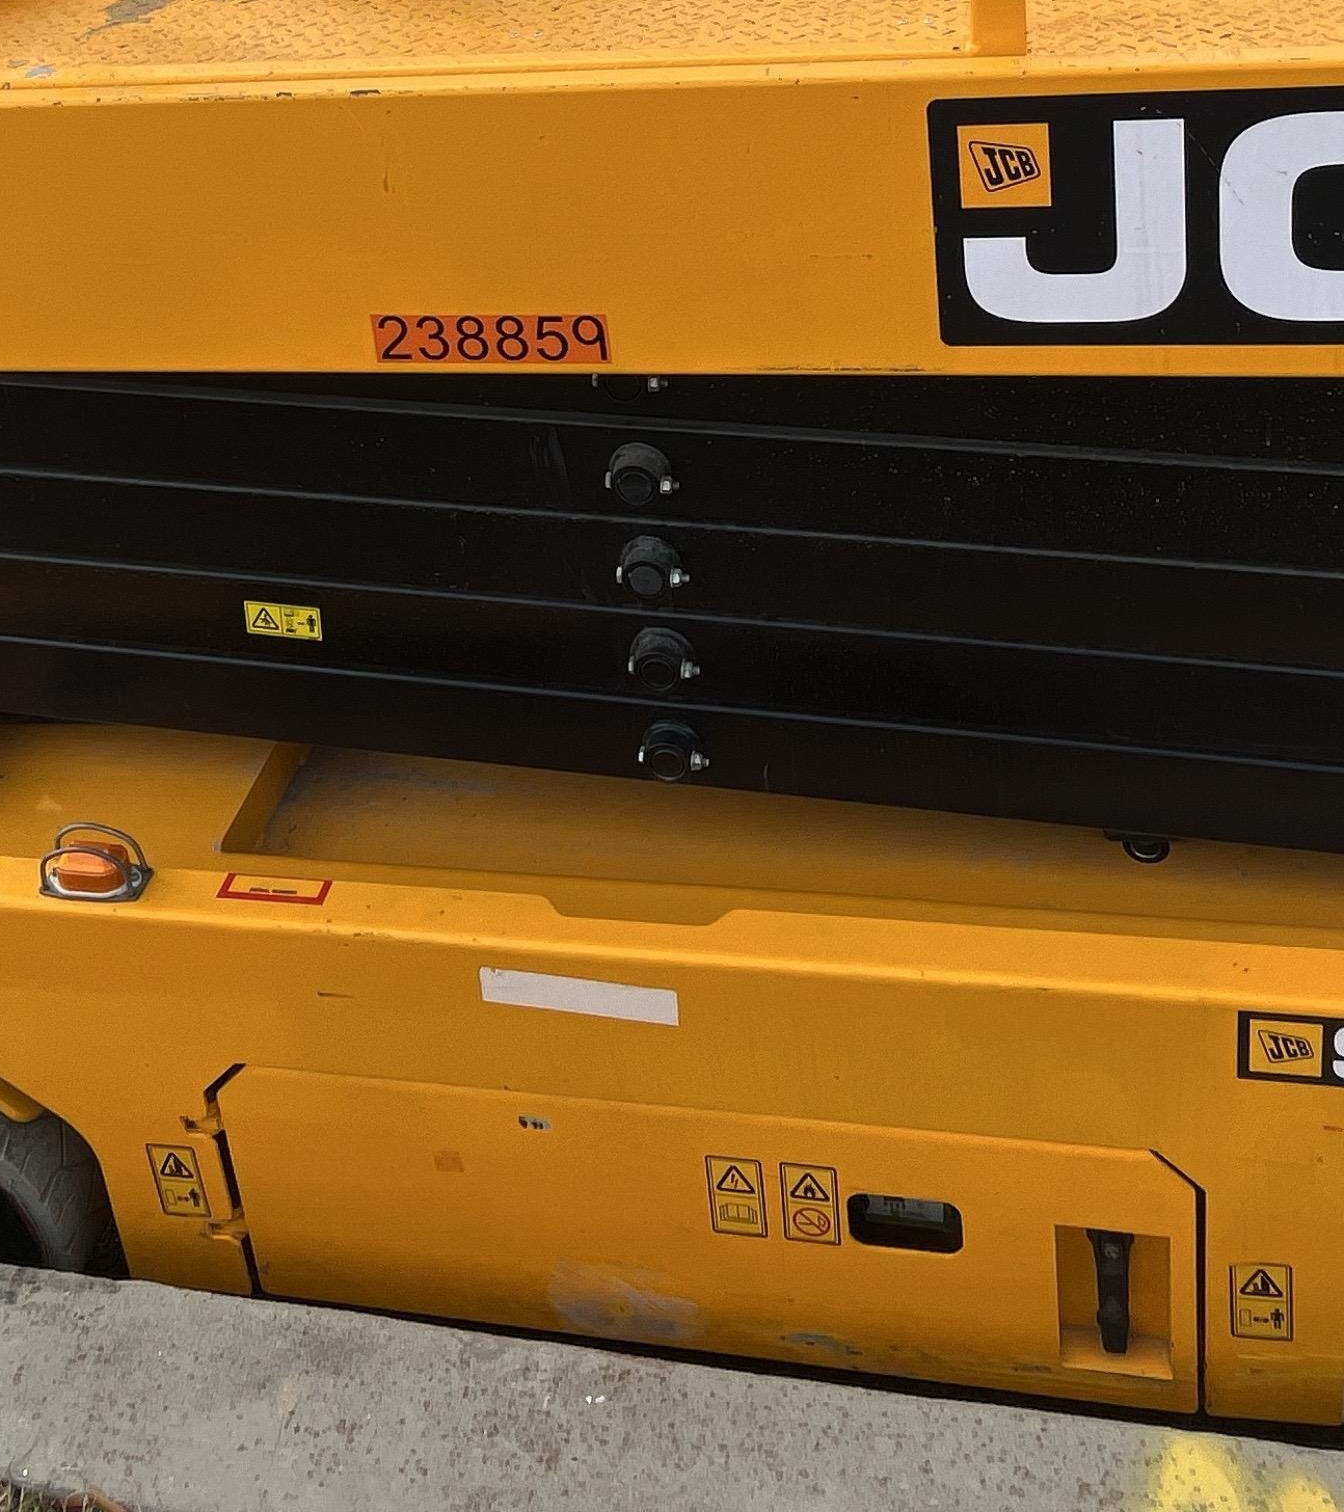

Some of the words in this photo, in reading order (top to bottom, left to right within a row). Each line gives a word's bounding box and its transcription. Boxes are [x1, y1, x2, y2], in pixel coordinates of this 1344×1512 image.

[981, 146, 1036, 186] JCB
[377, 315, 608, 361] 238859
[1268, 1034, 1311, 1060] JCB
